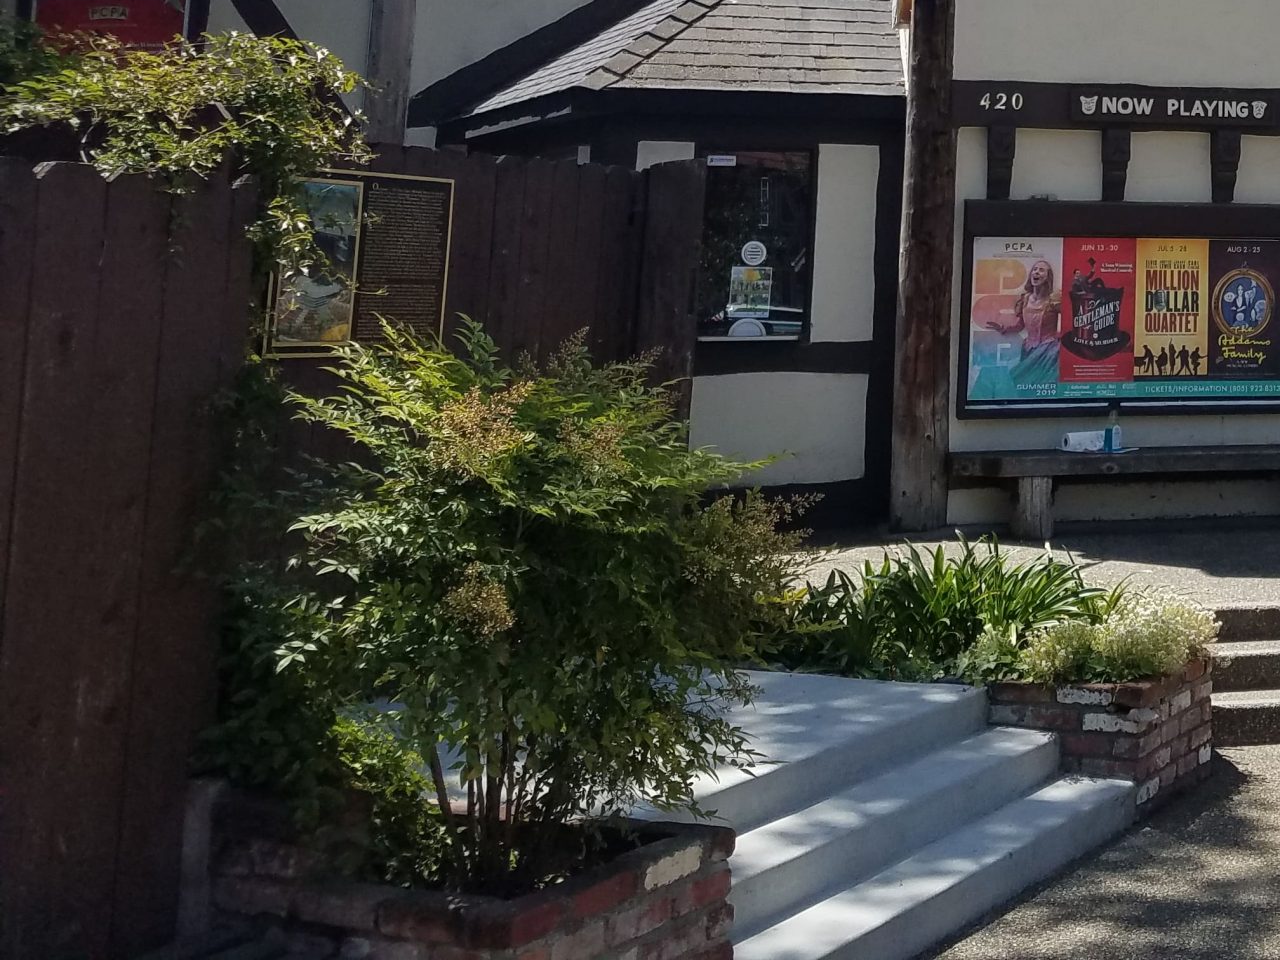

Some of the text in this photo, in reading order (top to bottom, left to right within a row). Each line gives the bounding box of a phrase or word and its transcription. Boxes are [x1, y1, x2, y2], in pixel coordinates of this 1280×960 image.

[90, 7, 129, 20] PCPA
[979, 92, 1024, 111] 420
[1101, 96, 1249, 119] NOW PLAYING
[1005, 243, 1034, 252] PCPA
[1081, 244, 1095, 252] JUN
[1145, 269, 1200, 291] MILLION
[1073, 300, 1120, 328] GENTLEMAN'S
[1093, 314, 1115, 331] GUIDE
[1144, 312, 1200, 333] QUARTET
[1222, 346, 1266, 365] Family
